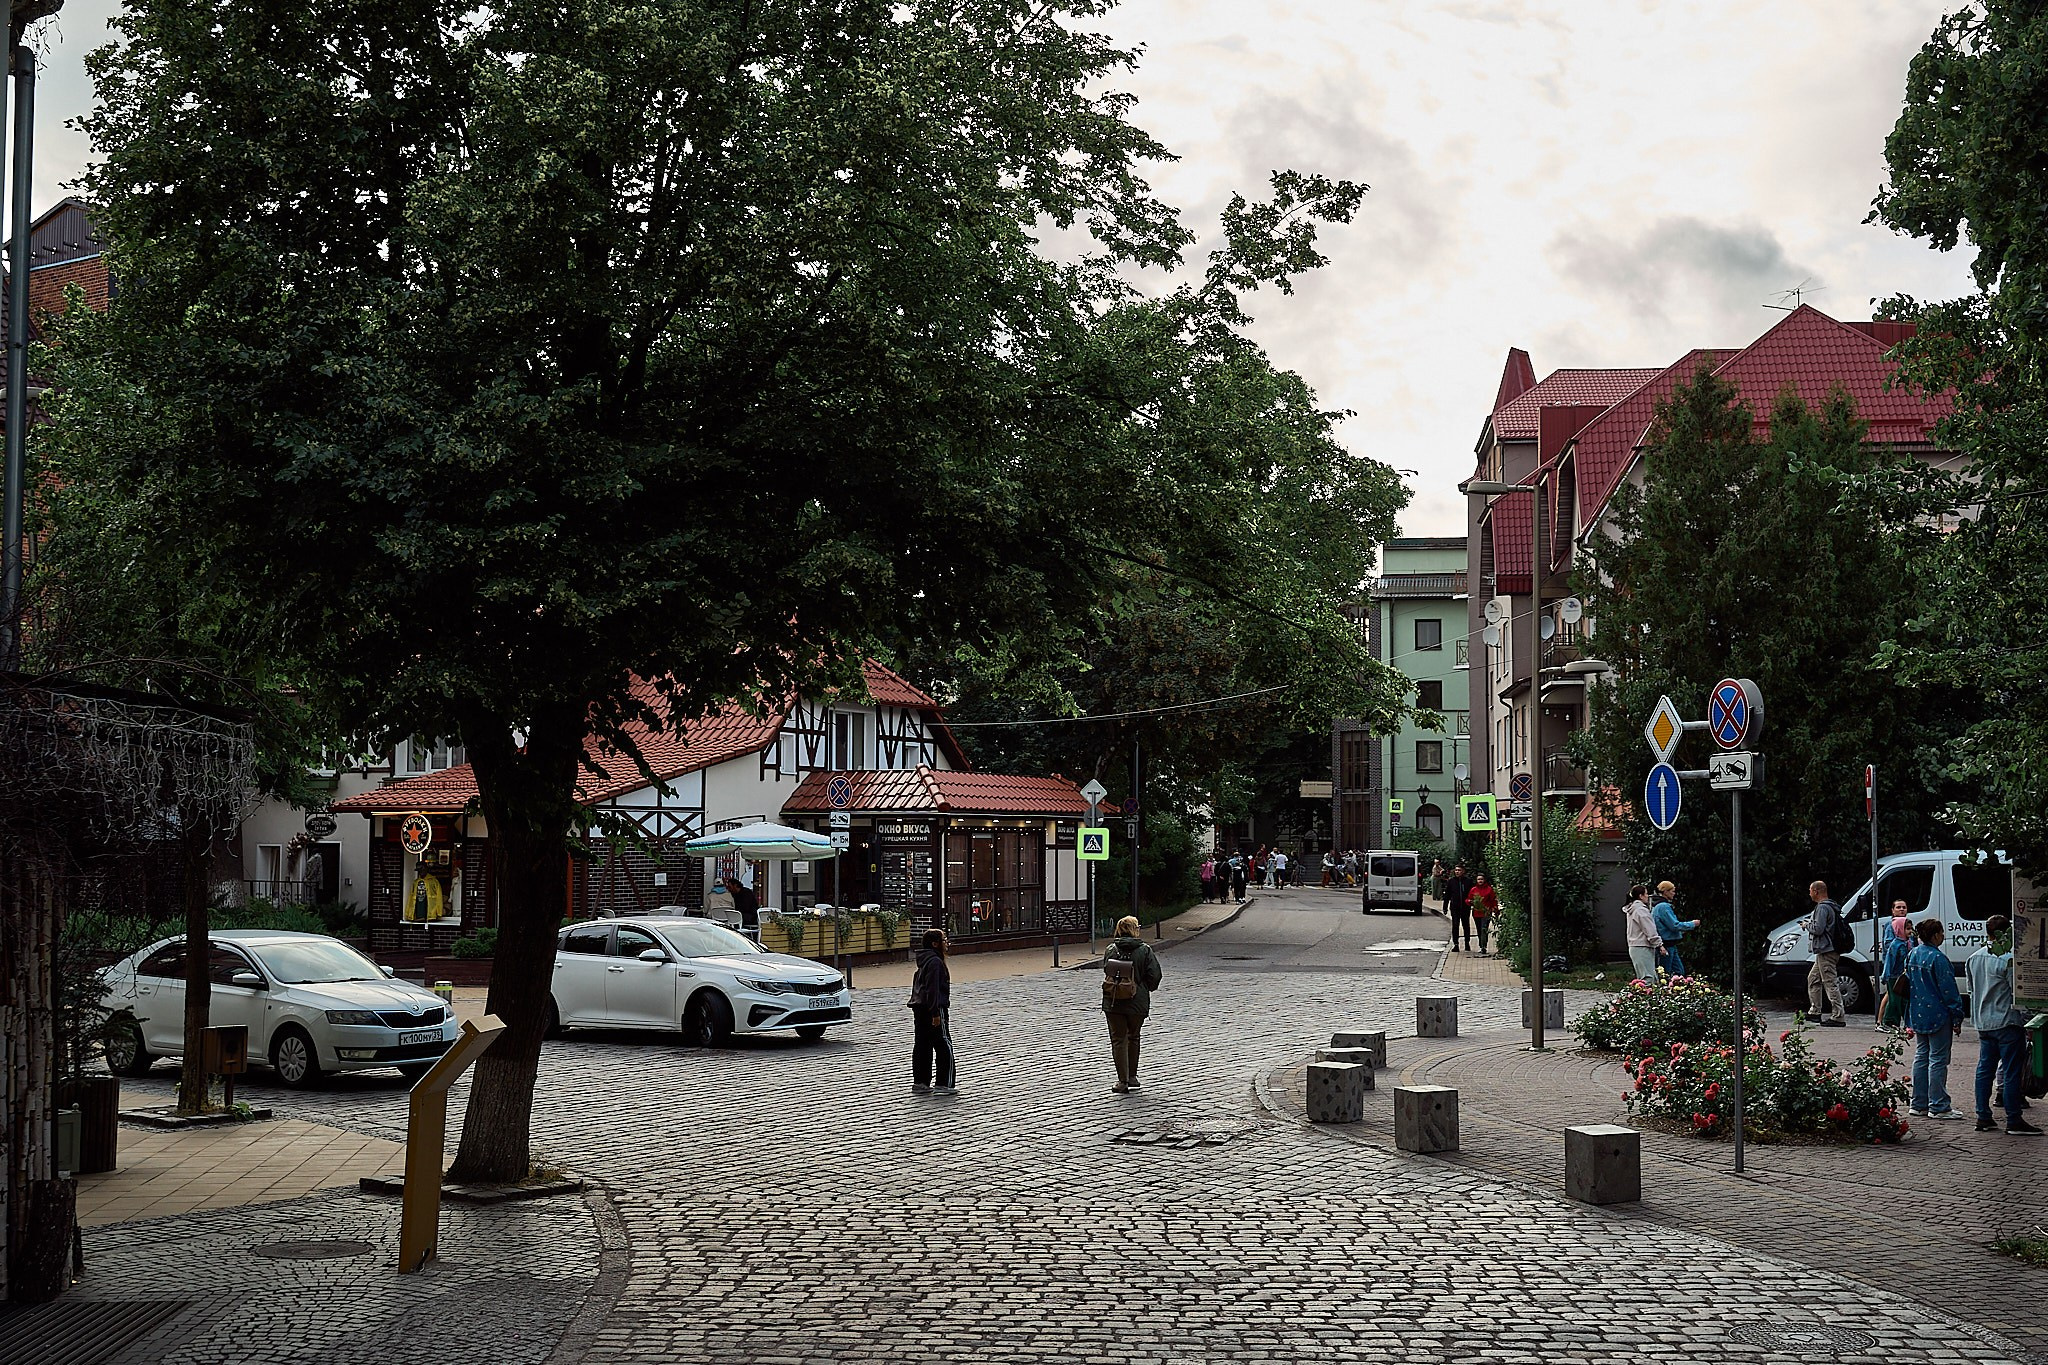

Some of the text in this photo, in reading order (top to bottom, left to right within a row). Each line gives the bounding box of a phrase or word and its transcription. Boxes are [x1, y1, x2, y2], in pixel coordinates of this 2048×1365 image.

[878, 824, 931, 834] ОКНО ВКУСА
[1948, 922, 1983, 932] ЗАКАЗ
